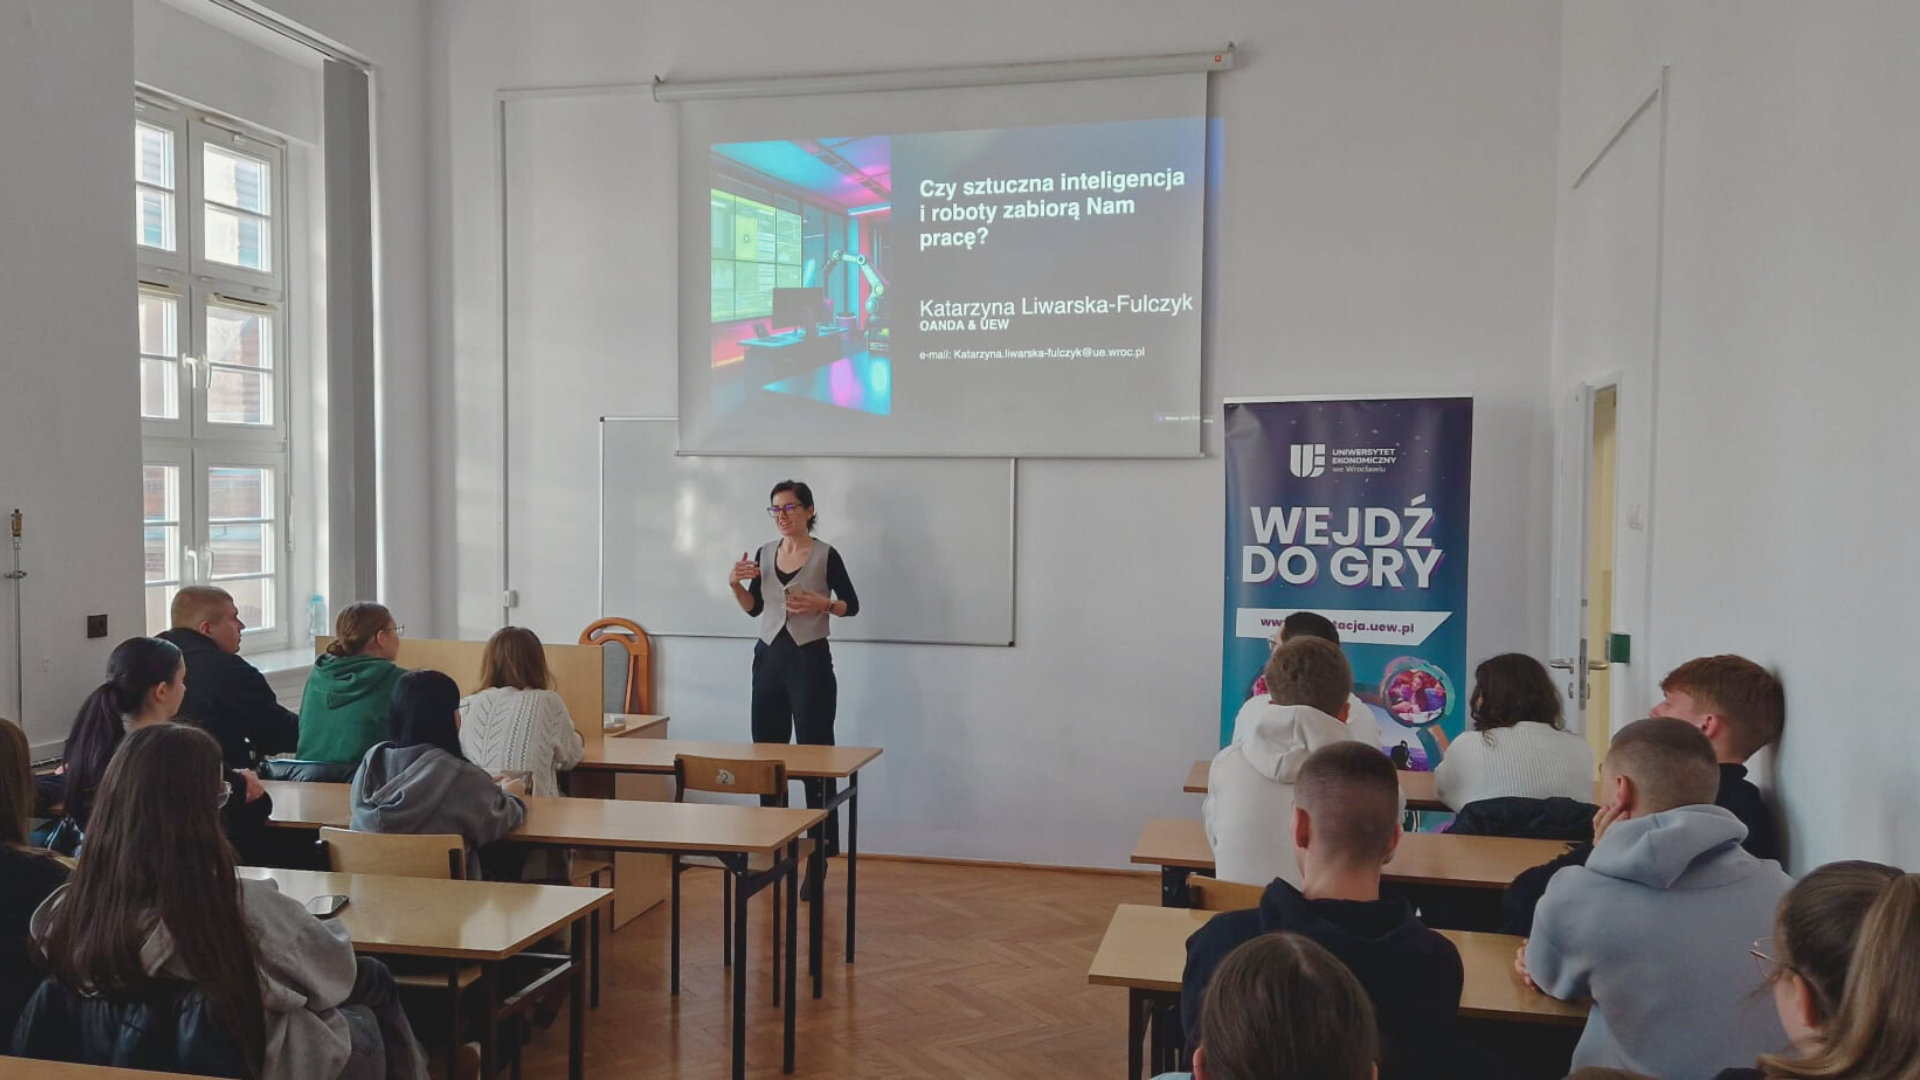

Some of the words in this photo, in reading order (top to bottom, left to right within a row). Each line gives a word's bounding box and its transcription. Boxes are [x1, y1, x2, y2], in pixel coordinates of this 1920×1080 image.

[919, 179, 956, 200] Czy
[962, 176, 1054, 196] sztuczna
[1060, 168, 1186, 192] inteligencja
[919, 205, 925, 222] i
[931, 203, 997, 224] roboty
[1003, 199, 1080, 220] zabiorą
[1086, 197, 1135, 215] Nam
[919, 227, 989, 251] pracę?
[920, 299, 1015, 320] Katarzyna
[1021, 293, 1193, 317] Liwarska-Fulczyk
[919, 320, 965, 332] OANDA
[968, 319, 976, 331] &
[980, 318, 1010, 330] UEW
[919, 349, 951, 360] e-mail:
[1346, 465, 1387, 473] Wrocławiu
[1250, 493, 1435, 548] WEJDŹ
[1242, 545, 1317, 584] DO
[1330, 548, 1444, 589] GRY
[1261, 617, 1415, 635] wwacja.uew.pl
